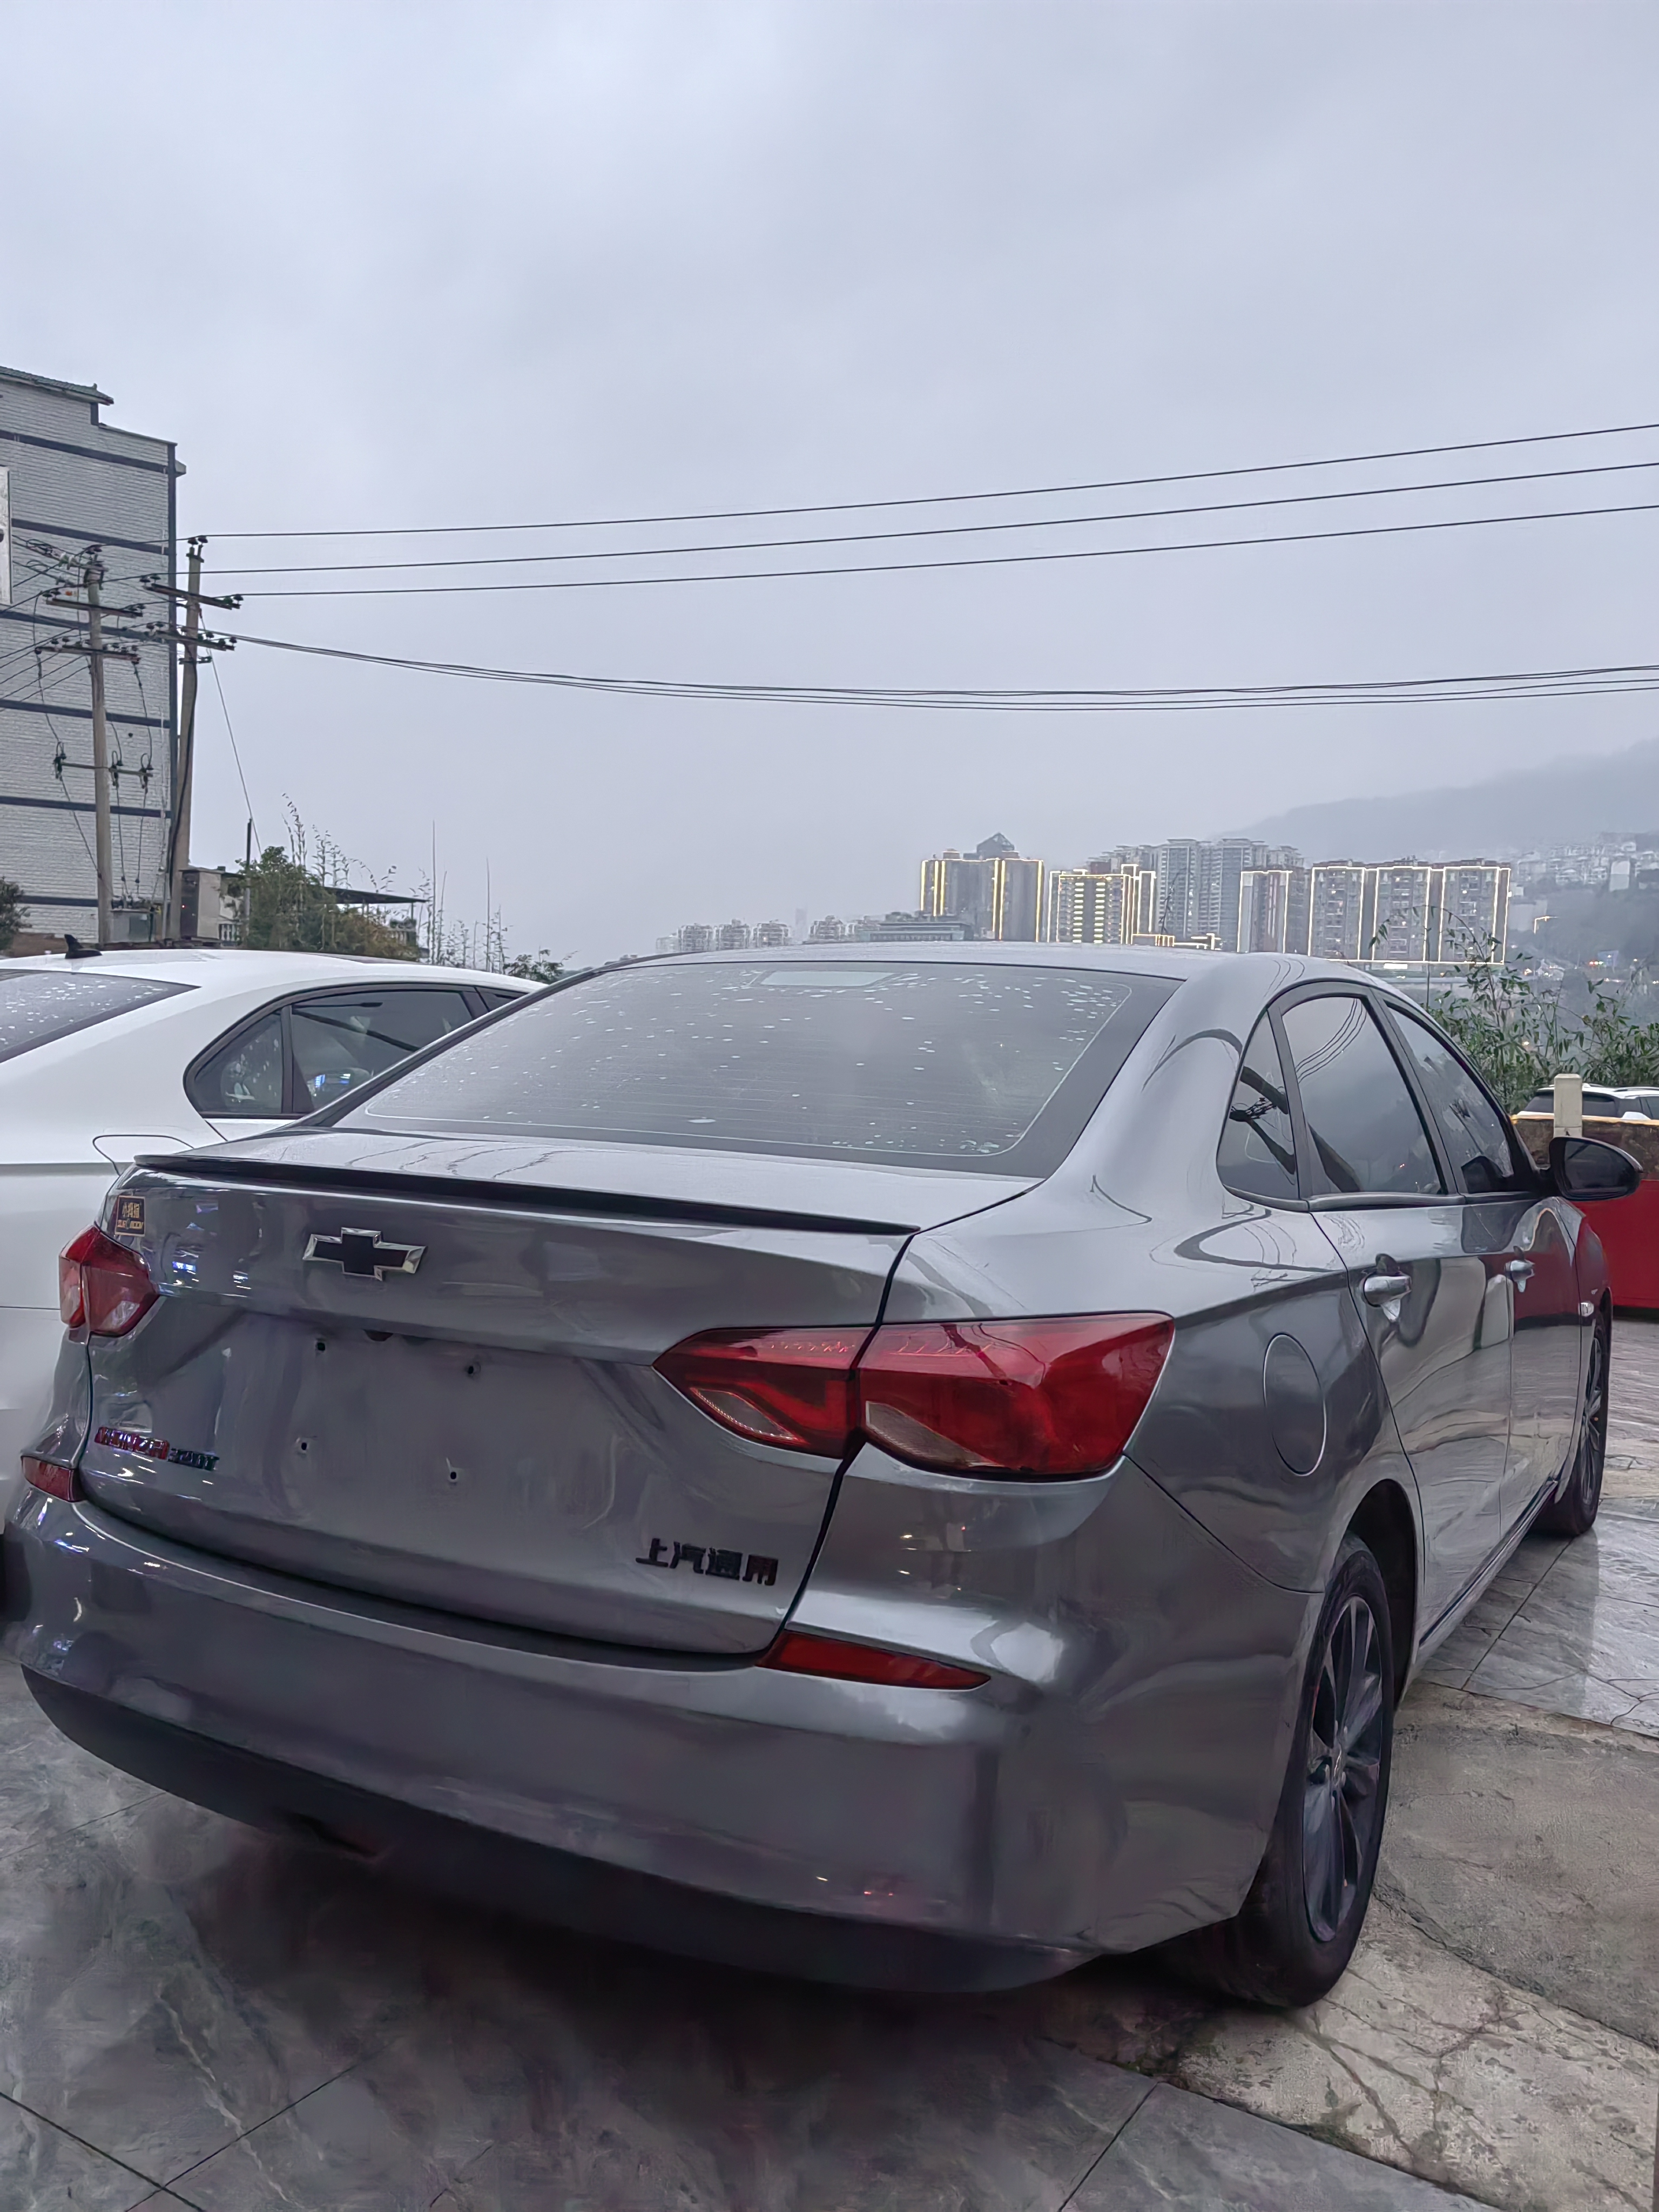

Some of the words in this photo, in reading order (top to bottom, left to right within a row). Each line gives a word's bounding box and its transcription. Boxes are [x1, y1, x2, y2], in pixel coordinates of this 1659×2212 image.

[94, 1426, 170, 1460] MONZA
[635, 1537, 779, 1586] 上汽通用
